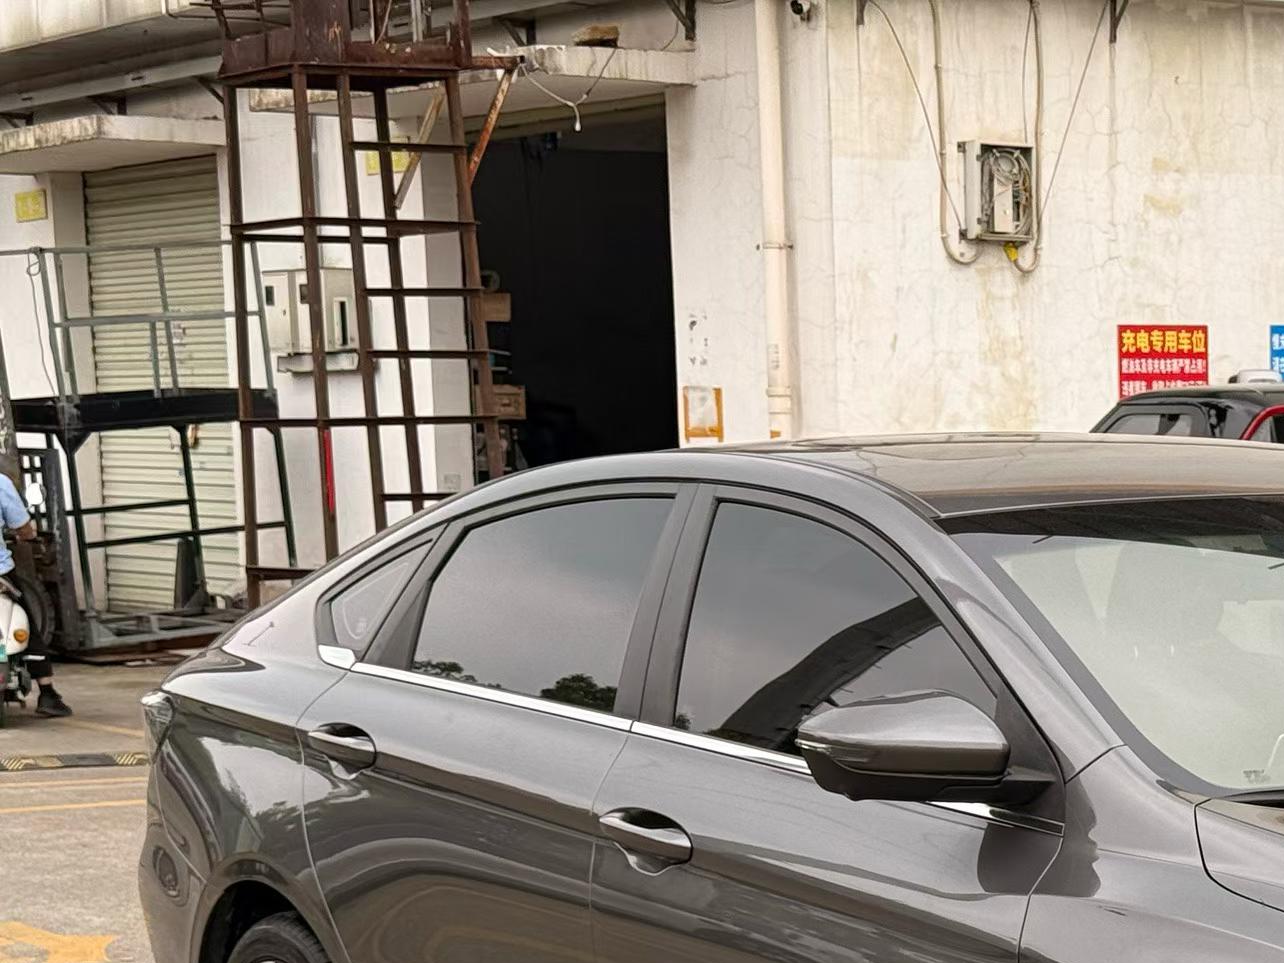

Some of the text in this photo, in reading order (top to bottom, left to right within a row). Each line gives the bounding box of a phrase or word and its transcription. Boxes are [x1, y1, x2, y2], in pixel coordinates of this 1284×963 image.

[1121, 329, 1206, 353] 充电专用车位
